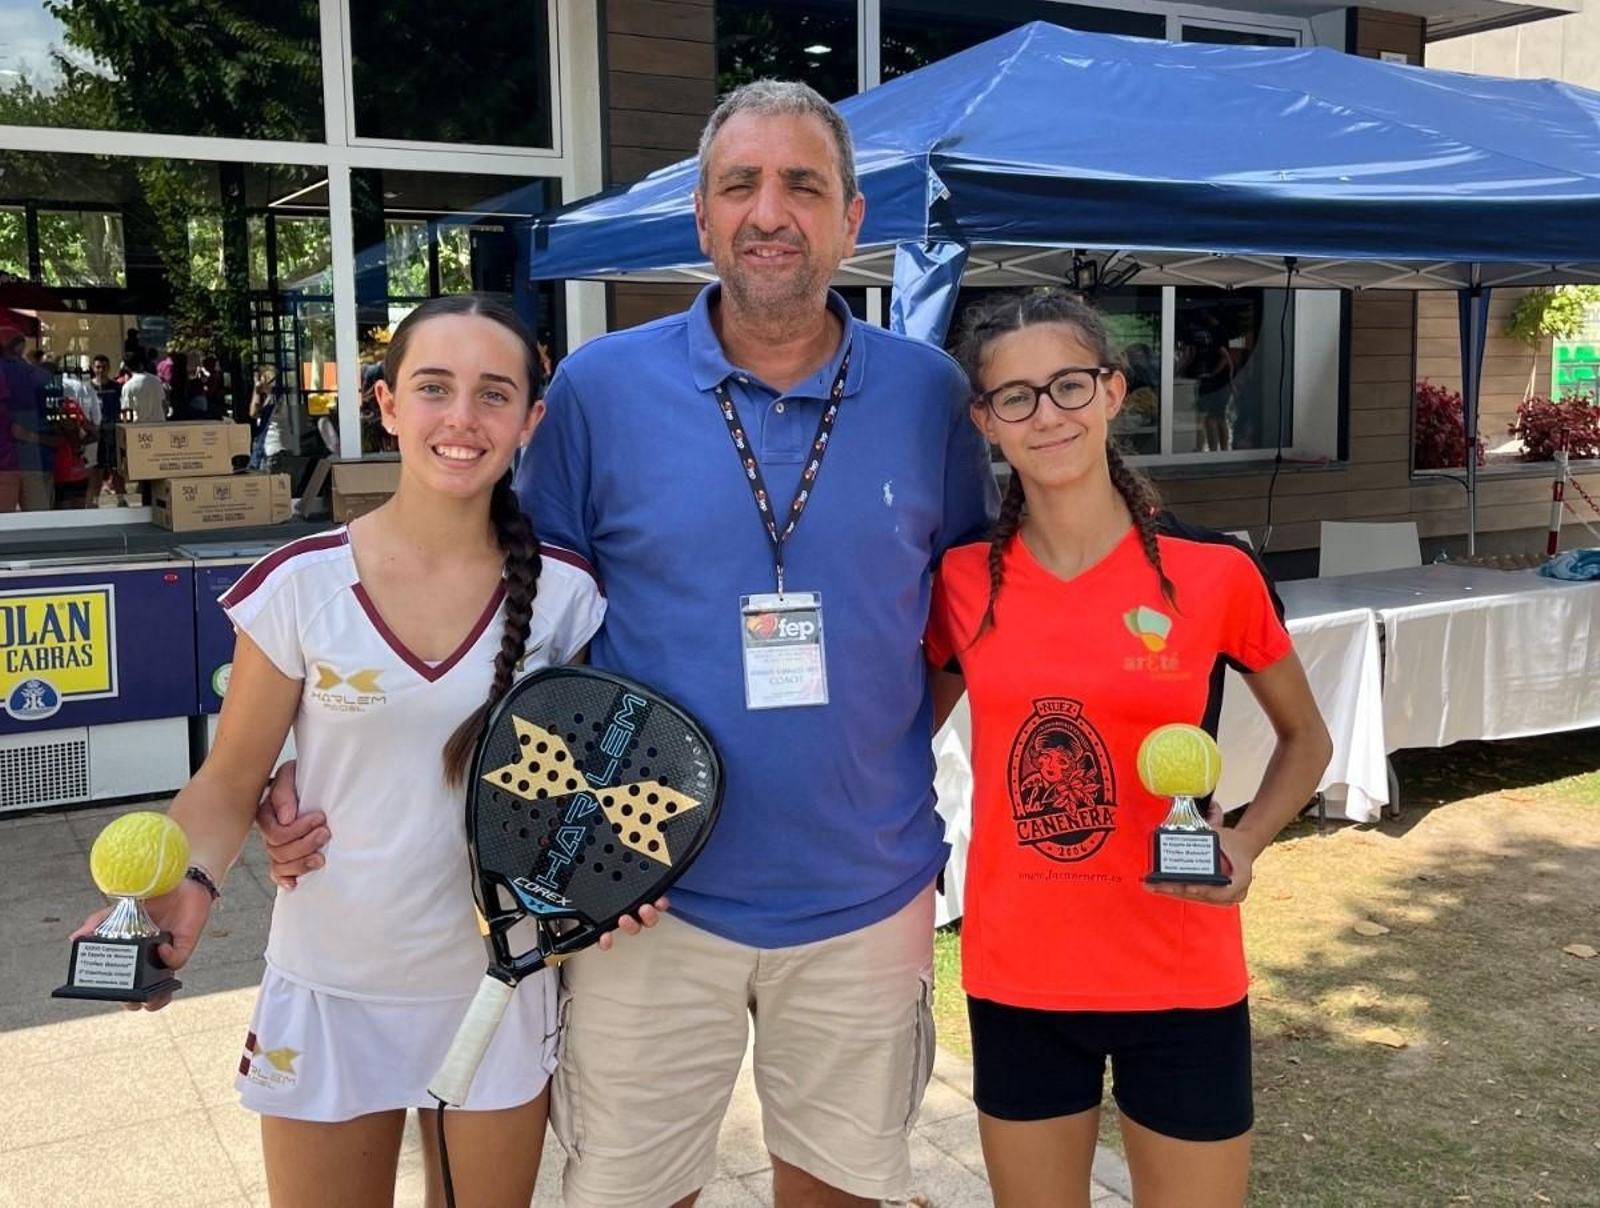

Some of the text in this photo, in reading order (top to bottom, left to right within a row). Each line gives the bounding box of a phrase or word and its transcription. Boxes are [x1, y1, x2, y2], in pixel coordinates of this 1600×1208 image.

[778, 618, 815, 641] fep
[6, 643, 93, 673] CABRAS
[311, 691, 387, 705] HARLEM
[1041, 701, 1073, 714] NUEZ
[536, 693, 648, 889] HARLEM
[1016, 807, 1115, 840] CANENERA
[512, 876, 573, 907] COREX
